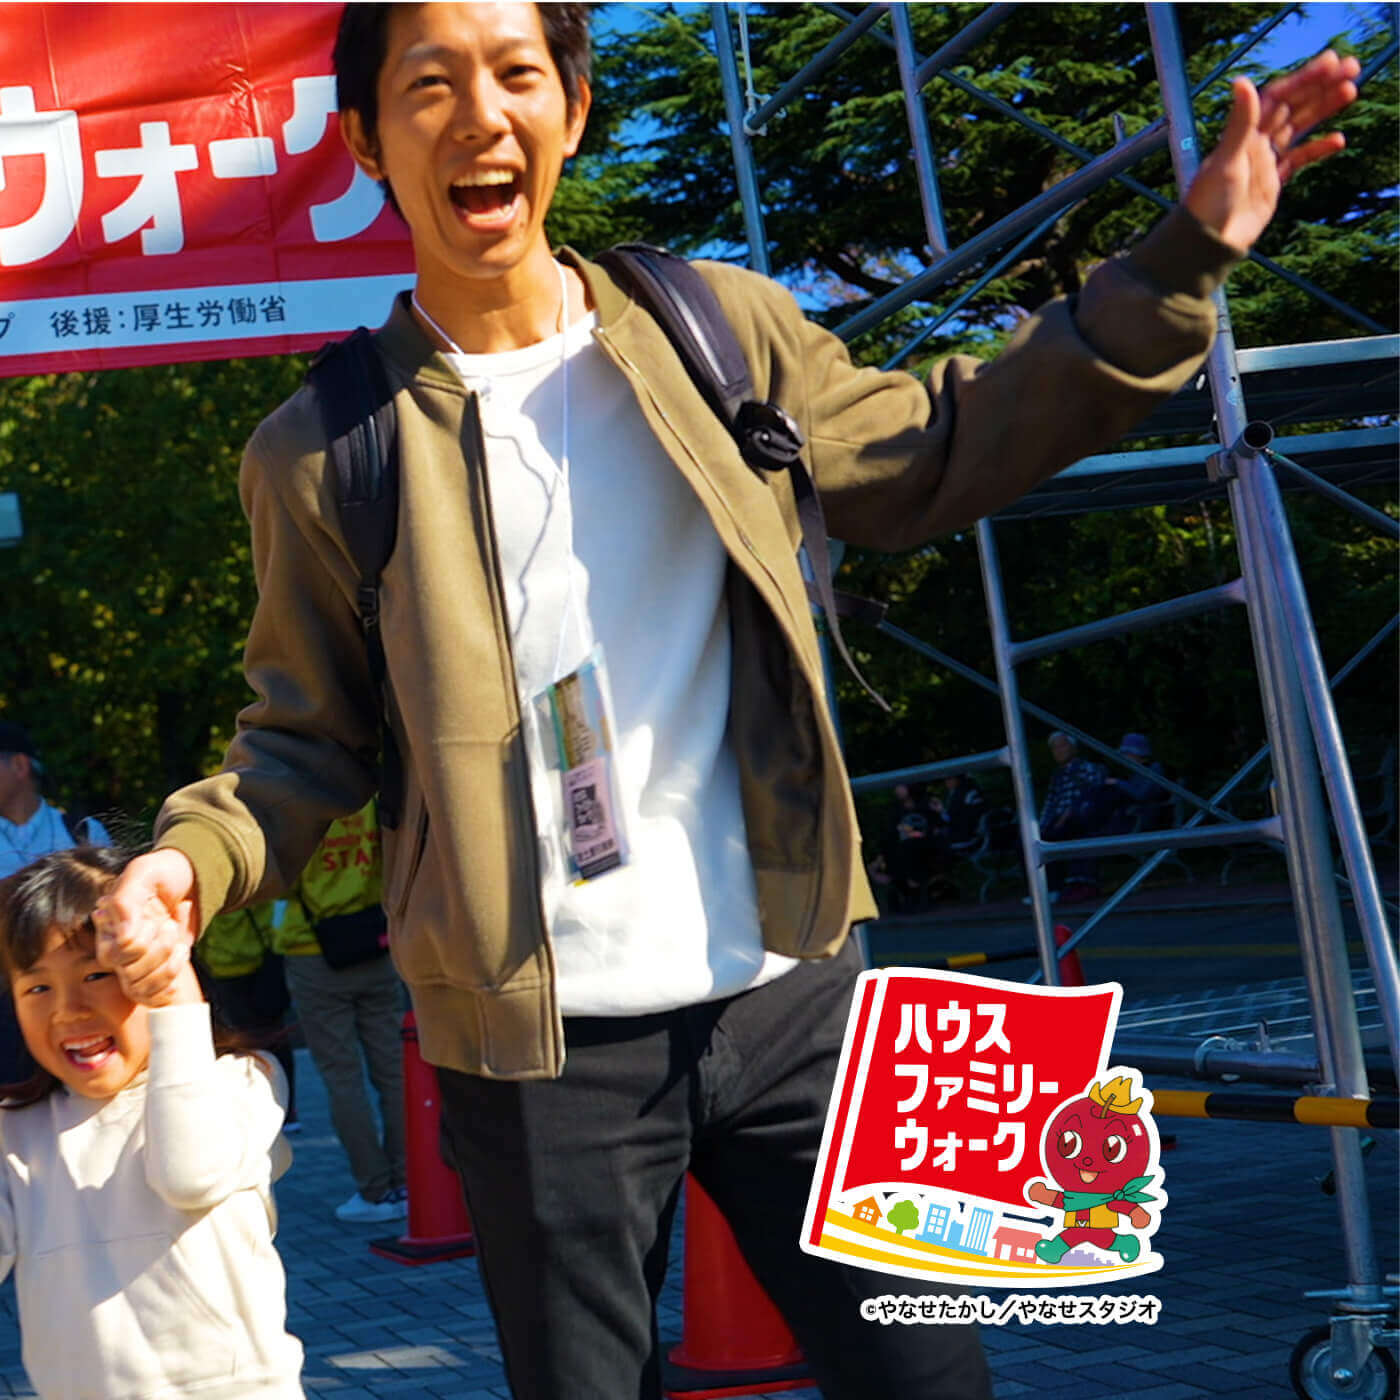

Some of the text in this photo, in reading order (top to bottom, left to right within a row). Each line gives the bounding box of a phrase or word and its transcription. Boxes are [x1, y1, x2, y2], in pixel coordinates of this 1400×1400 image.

[50, 295, 287, 338] 後援：厚生労働省
